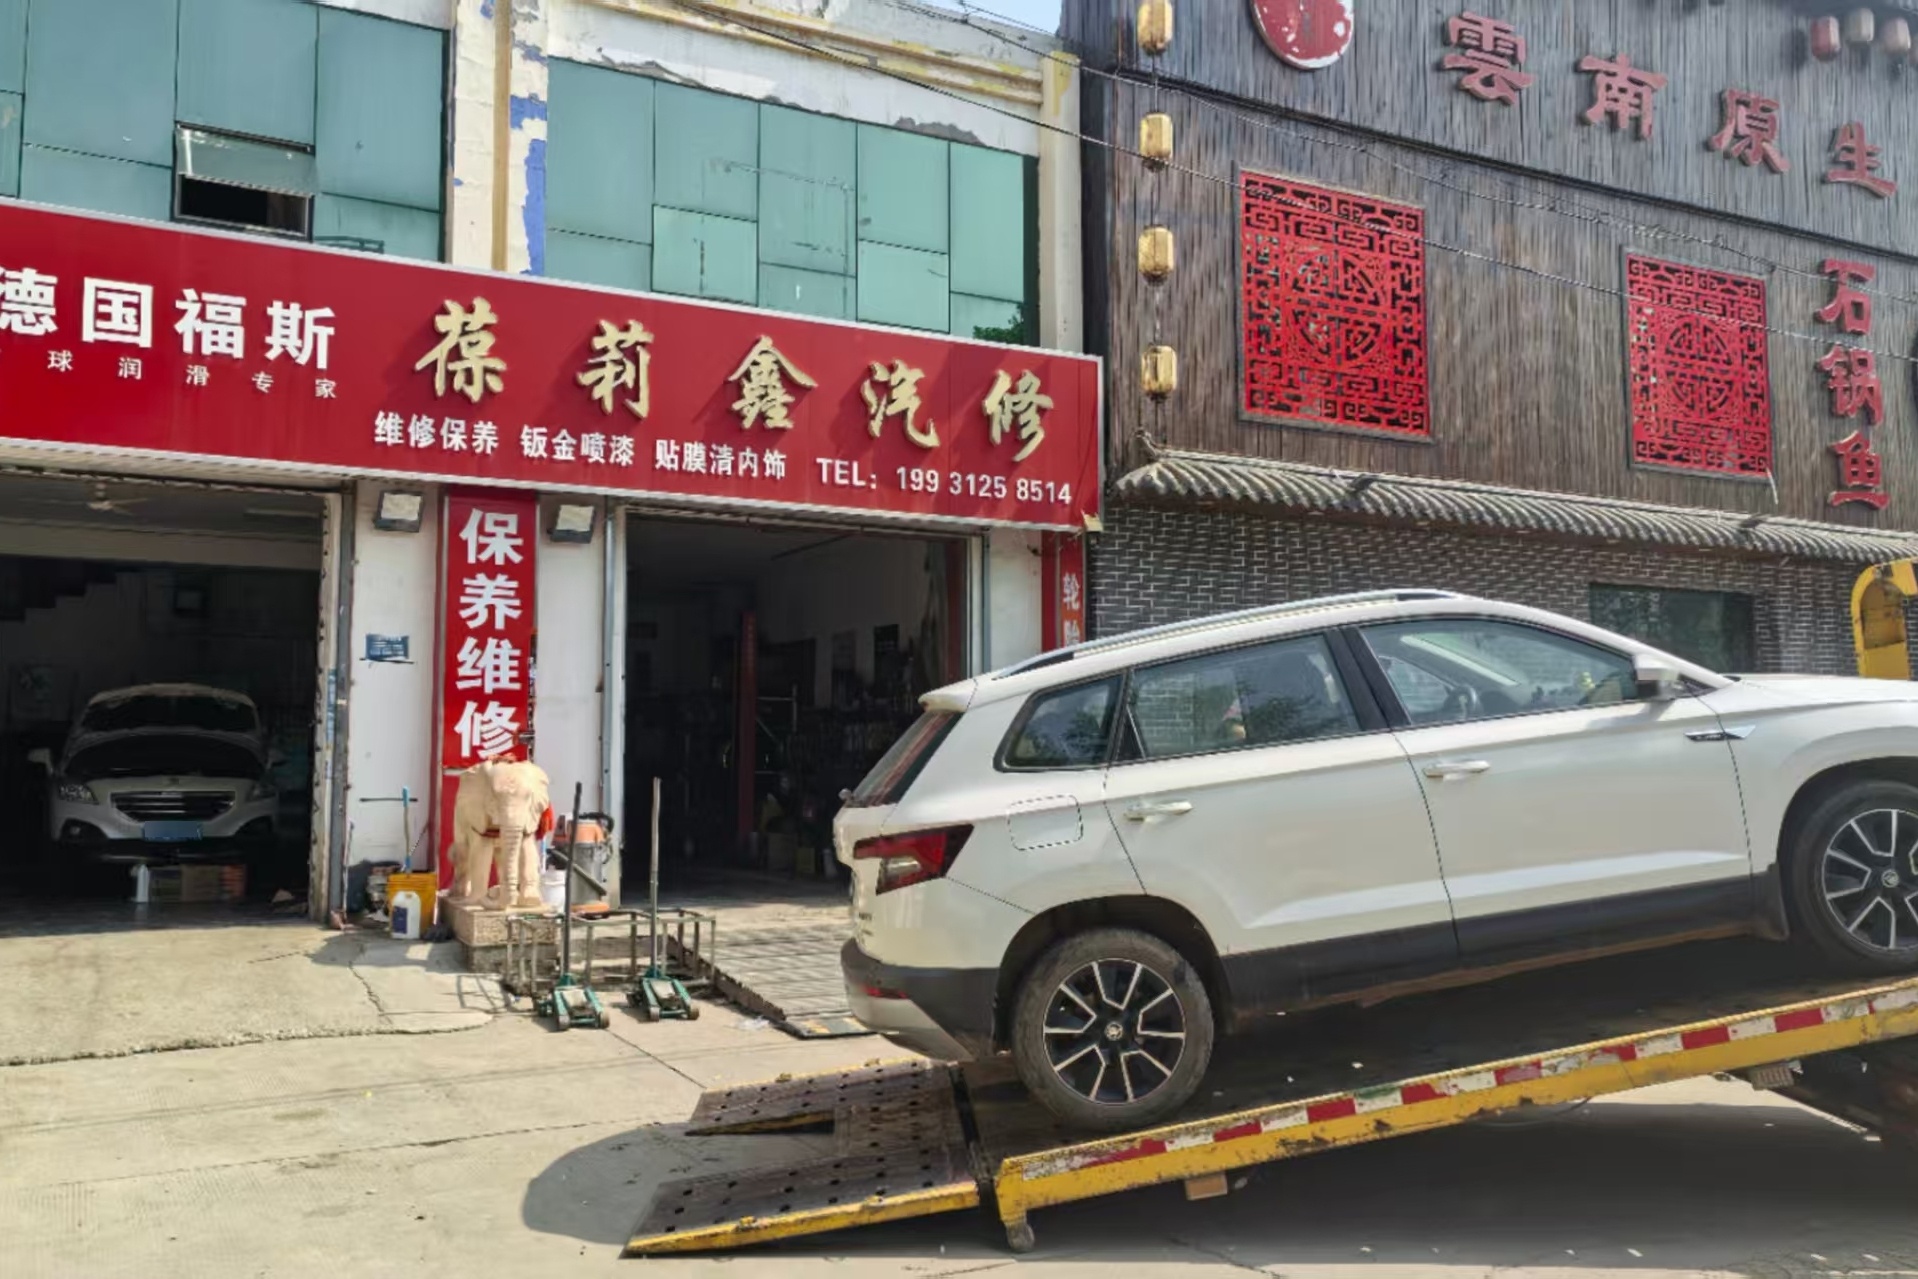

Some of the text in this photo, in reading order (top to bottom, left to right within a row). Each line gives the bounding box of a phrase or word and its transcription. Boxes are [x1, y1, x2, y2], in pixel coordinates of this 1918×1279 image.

[1443, 10, 1897, 198] 雲南原生
[0, 265, 335, 370] 德国福斯
[415, 296, 1054, 462] 葆莉鑫汽修
[1814, 258, 1891, 510] 石锅鱼
[374, 410, 1073, 505] 维修保养 钣金喷漆 贴膜清内饰 TEL: 199 3125 8514
[455, 507, 524, 759] 保养维修
